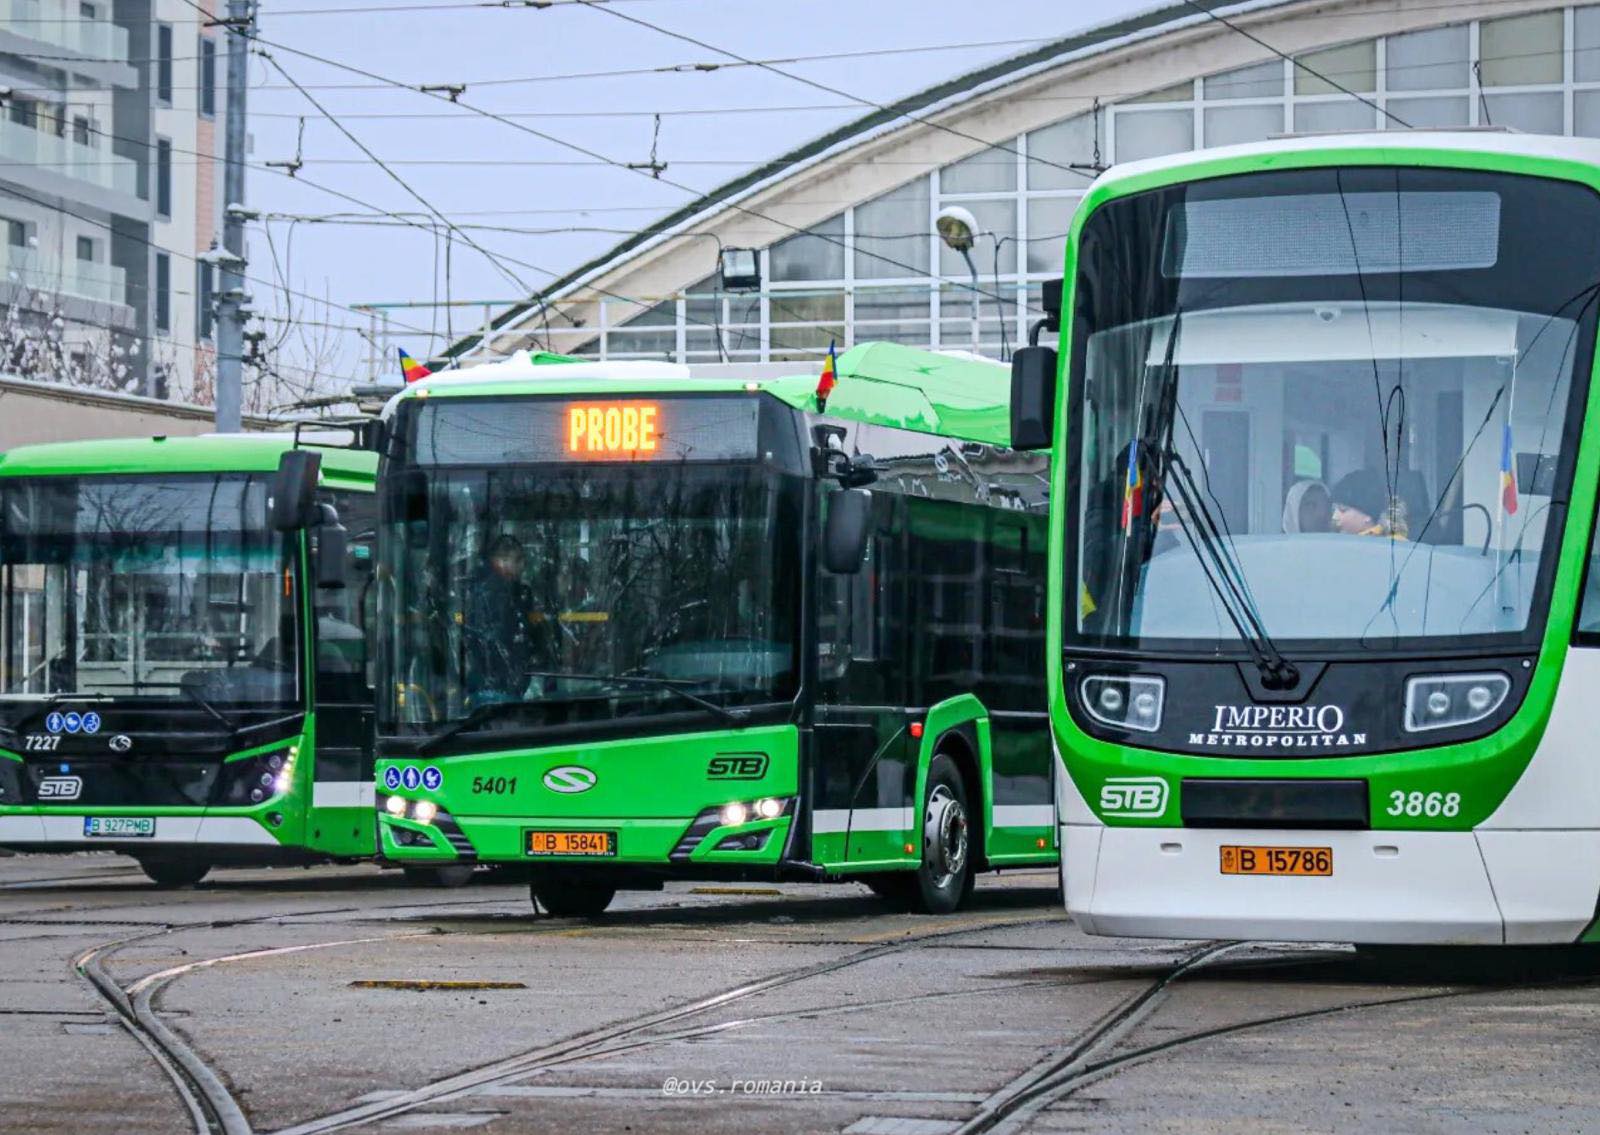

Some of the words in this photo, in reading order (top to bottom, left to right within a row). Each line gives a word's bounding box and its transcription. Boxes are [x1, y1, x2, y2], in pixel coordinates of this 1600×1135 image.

[569, 406, 657, 452] PROBE
[1211, 704, 1345, 733] IMPERIO
[25, 735, 61, 750] 7227
[1188, 733, 1367, 747] METROPOLITAN
[707, 755, 766, 777] STB
[38, 779, 79, 797] STB
[472, 776, 518, 795] 5401
[1101, 782, 1165, 813] STB
[1386, 790, 1461, 817] 3868
[92, 818, 100, 831] B
[546, 834, 557, 850] B
[565, 834, 604, 850] 15841
[1240, 851, 1256, 872] B
[1266, 850, 1329, 872] 15786
